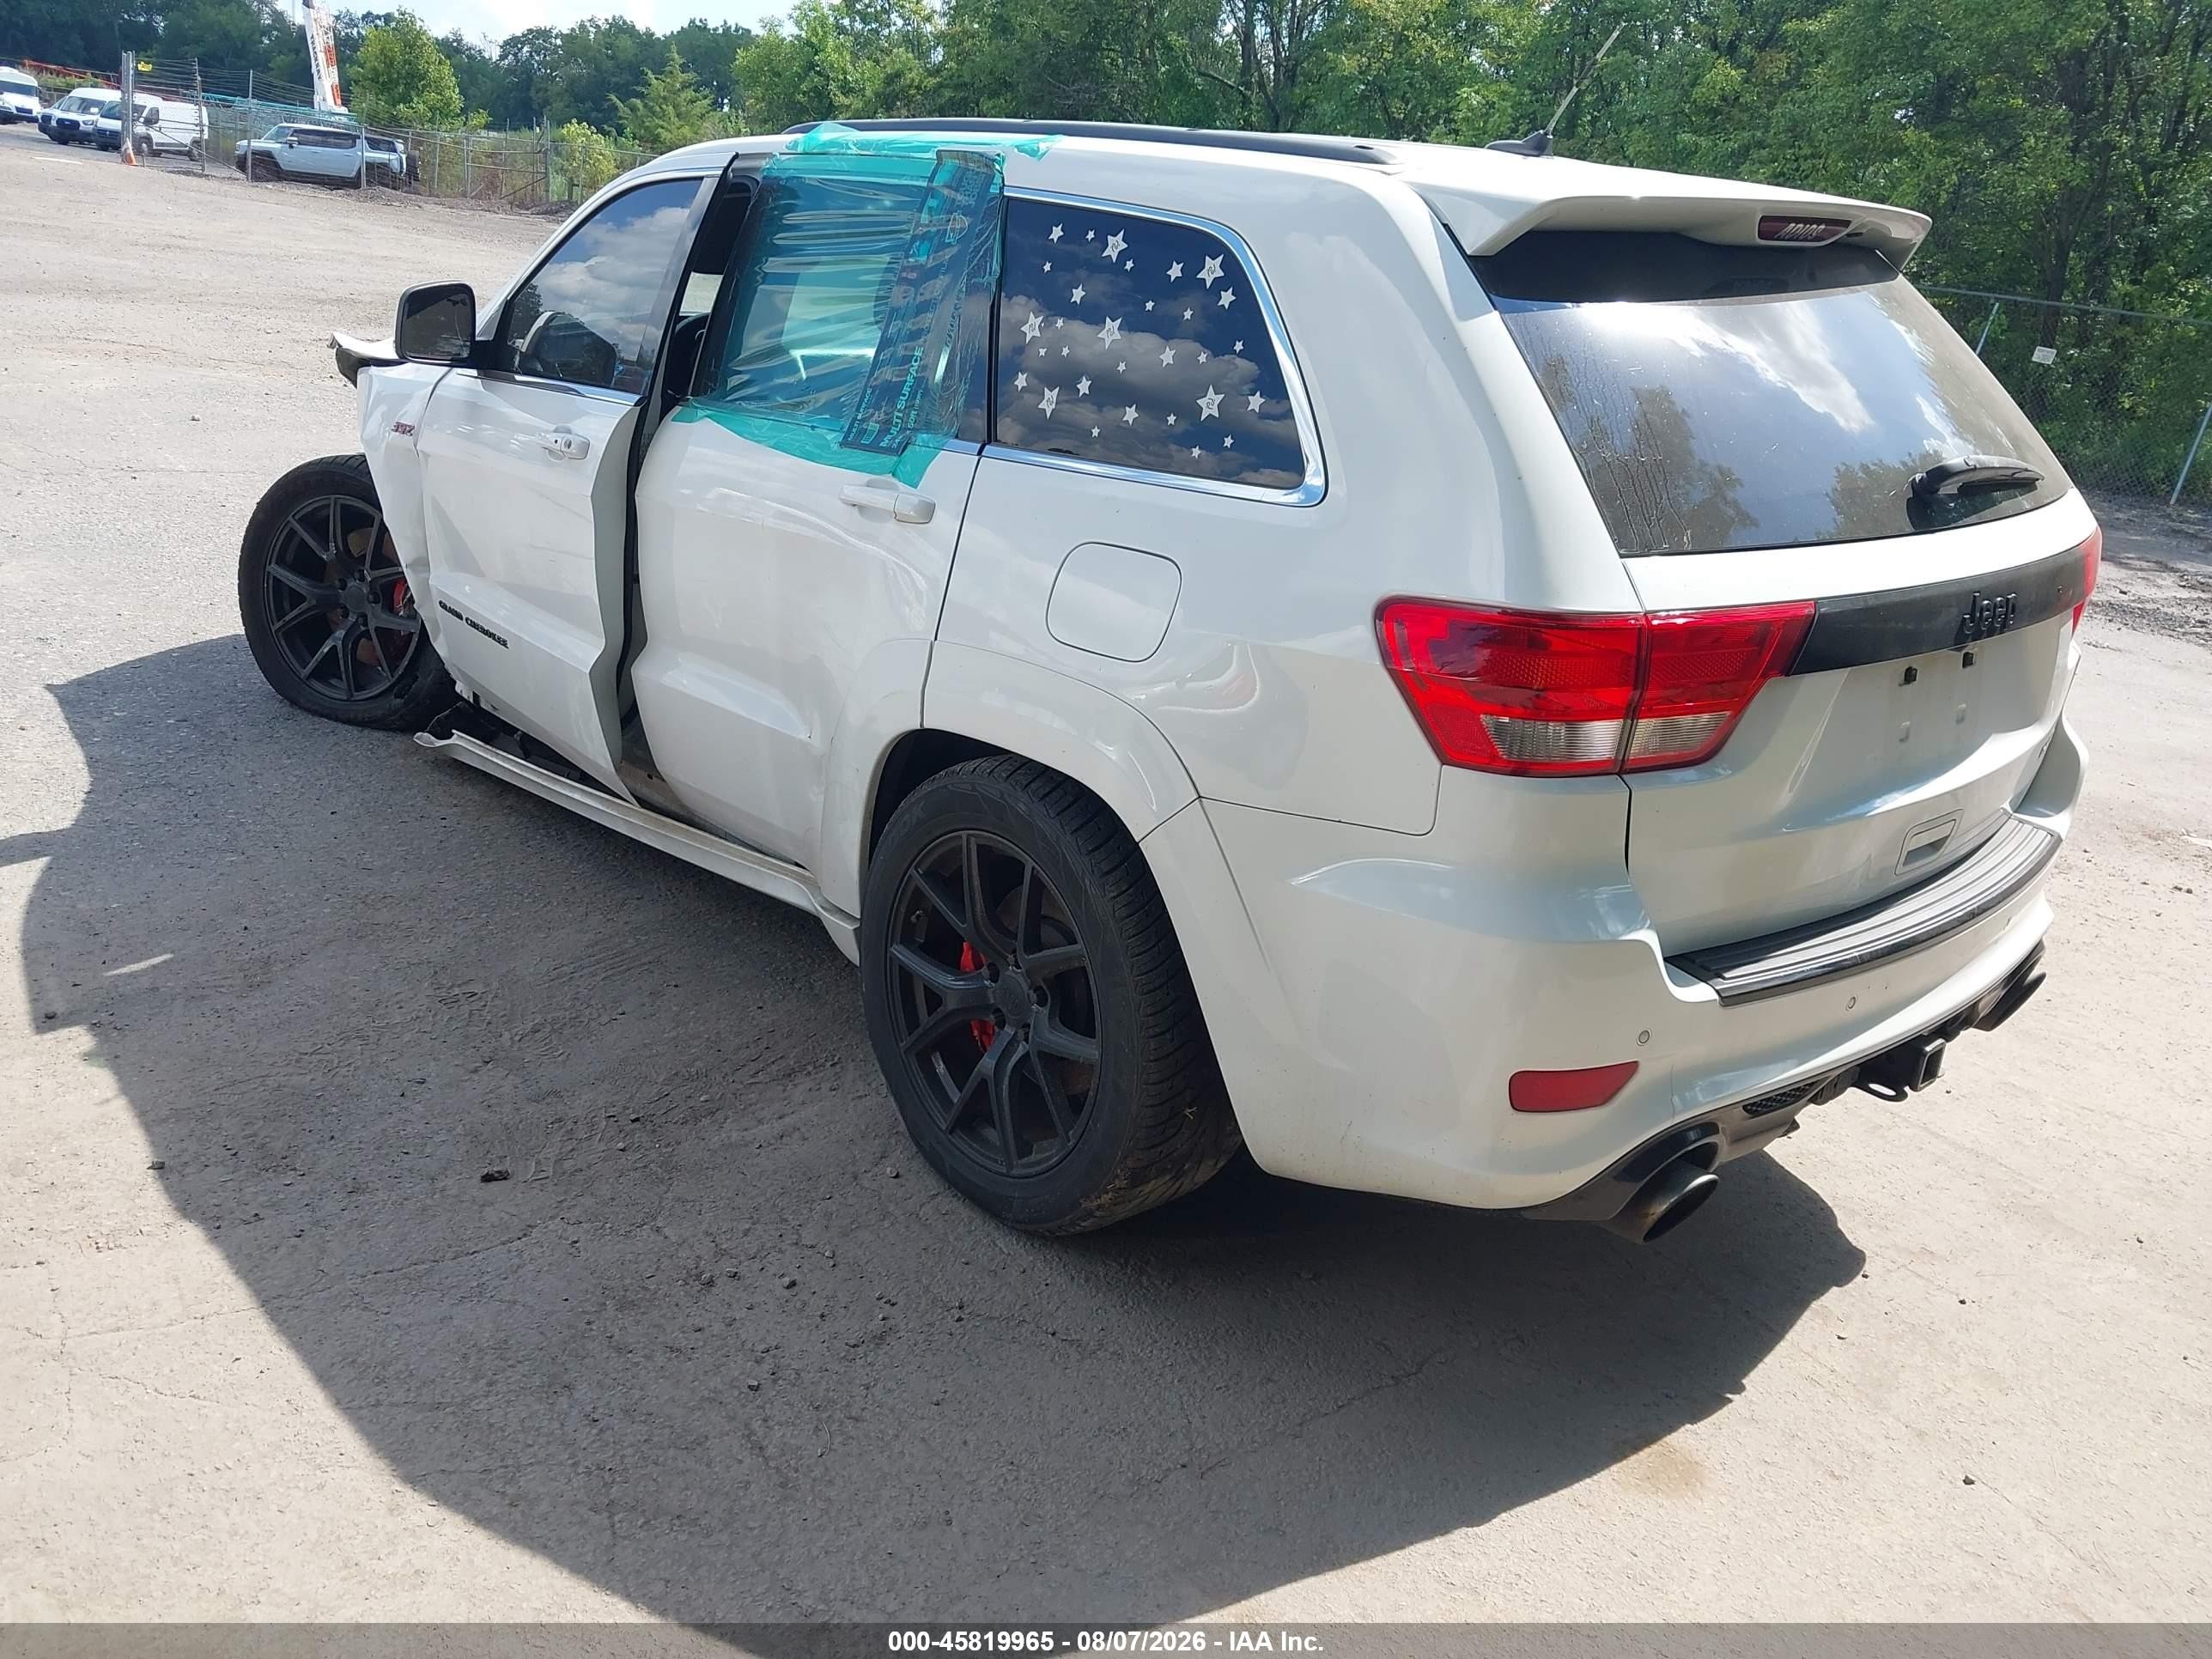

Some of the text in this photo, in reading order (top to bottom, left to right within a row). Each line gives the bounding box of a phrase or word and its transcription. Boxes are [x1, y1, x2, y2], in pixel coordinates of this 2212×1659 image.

[879, 411, 903, 447] MULTI
[897, 345, 923, 410] SURFACE
[1961, 591, 2018, 634] Jeep
